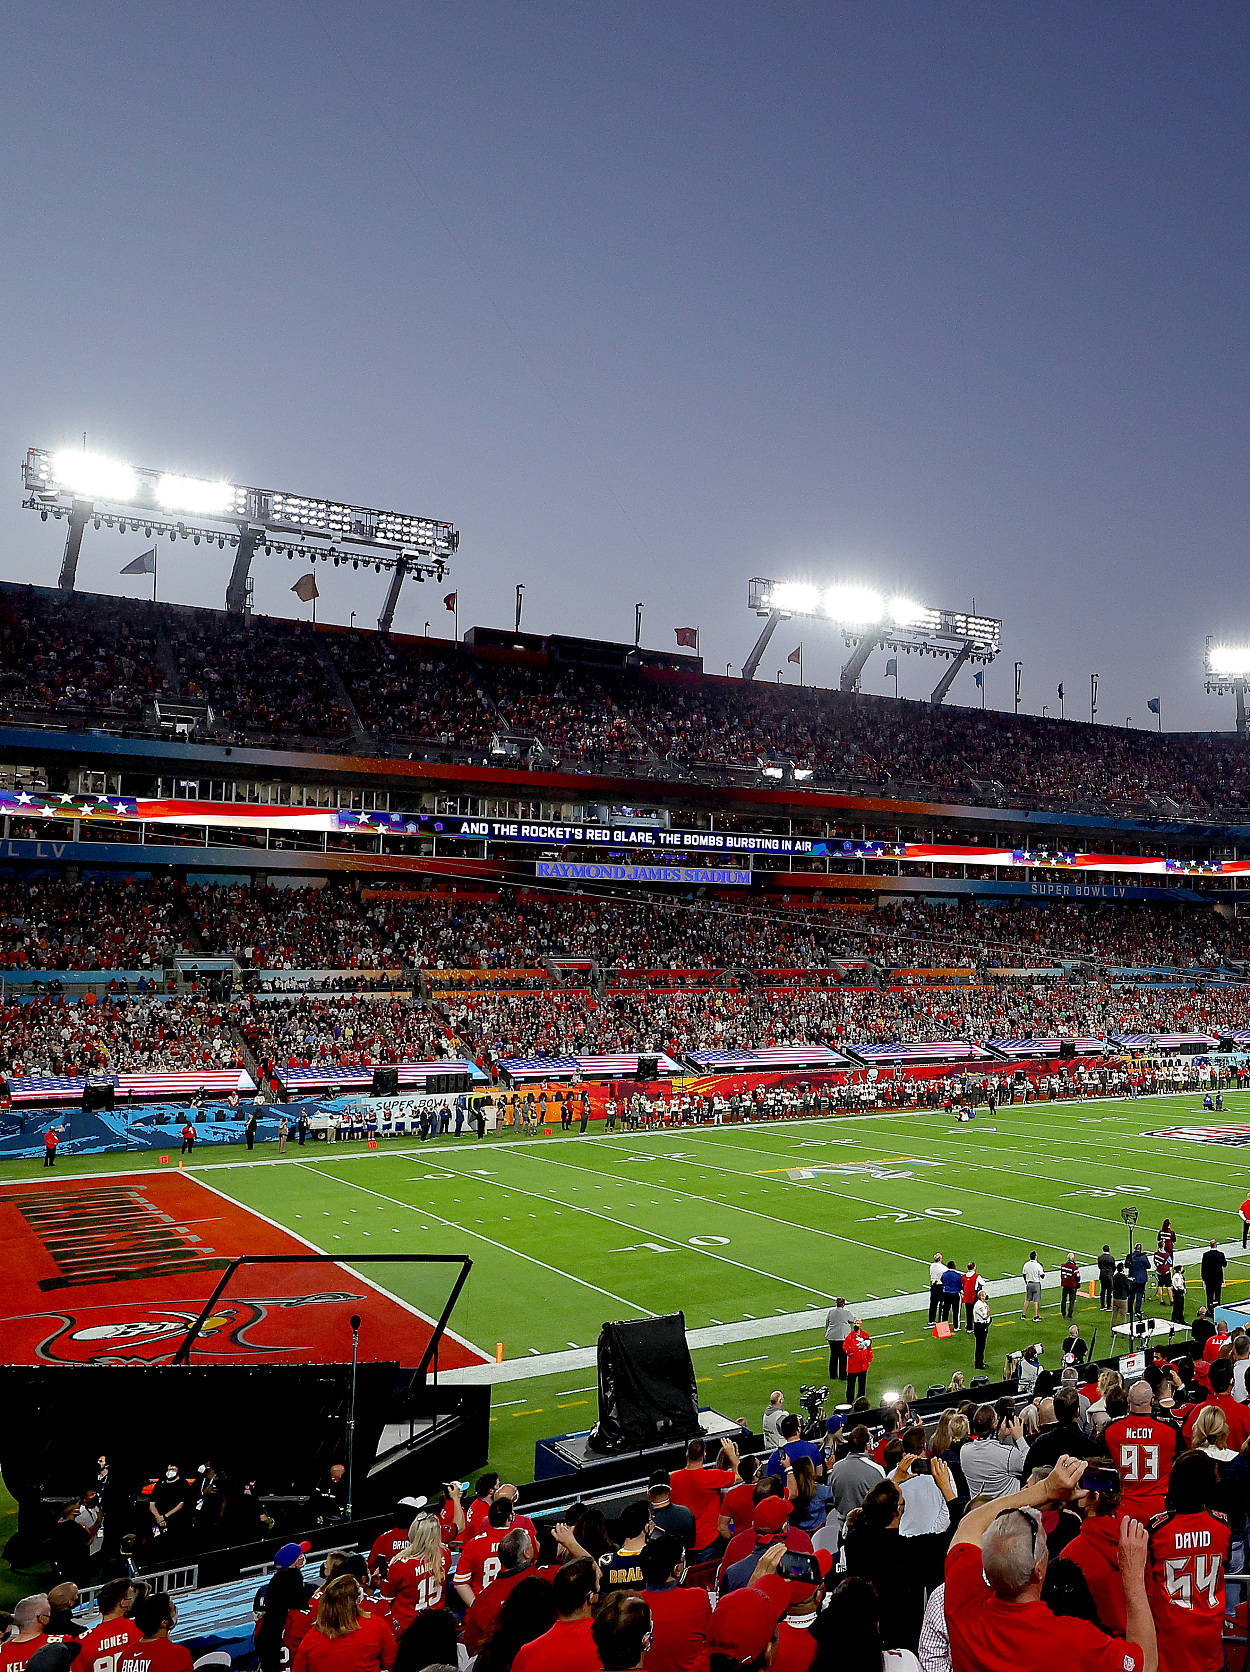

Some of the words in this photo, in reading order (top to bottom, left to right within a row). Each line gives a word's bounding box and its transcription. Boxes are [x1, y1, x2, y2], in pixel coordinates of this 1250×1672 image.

[461, 822, 488, 834] AND
[493, 824, 518, 836] THE
[522, 825, 582, 840] ROCKET'S
[586, 829, 610, 841] RED
[614, 831, 655, 845] GLARE,
[659, 833, 681, 845] THE
[684, 834, 723, 847] BOMBS
[726, 836, 779, 850] BURSTING
[782, 840, 792, 850] IN
[795, 841, 812, 852] AIR
[36, 843, 67, 858] LV
[538, 863, 627, 879] RAYMOND
[628, 866, 682, 882] JAMES
[684, 868, 751, 884] STADIUM
[1031, 884, 1070, 895] SUPER
[1075, 886, 1108, 897] BOWL
[1113, 887, 1126, 898] LV
[376, 1099, 415, 1111] SUPER
[417, 1098, 449, 1108] BOWL
[632, 1235, 731, 1254] 10
[1126, 1427, 1153, 1439] McCOY
[1120, 1443, 1160, 1481] 93
[1175, 1530, 1211, 1550] DAVID
[483, 1557, 502, 1590] 8
[1164, 1554, 1223, 1610] 54
[415, 1578, 443, 1611] 15
[98, 1632, 129, 1652] JONES
[121, 1659, 151, 1672] BRADY
